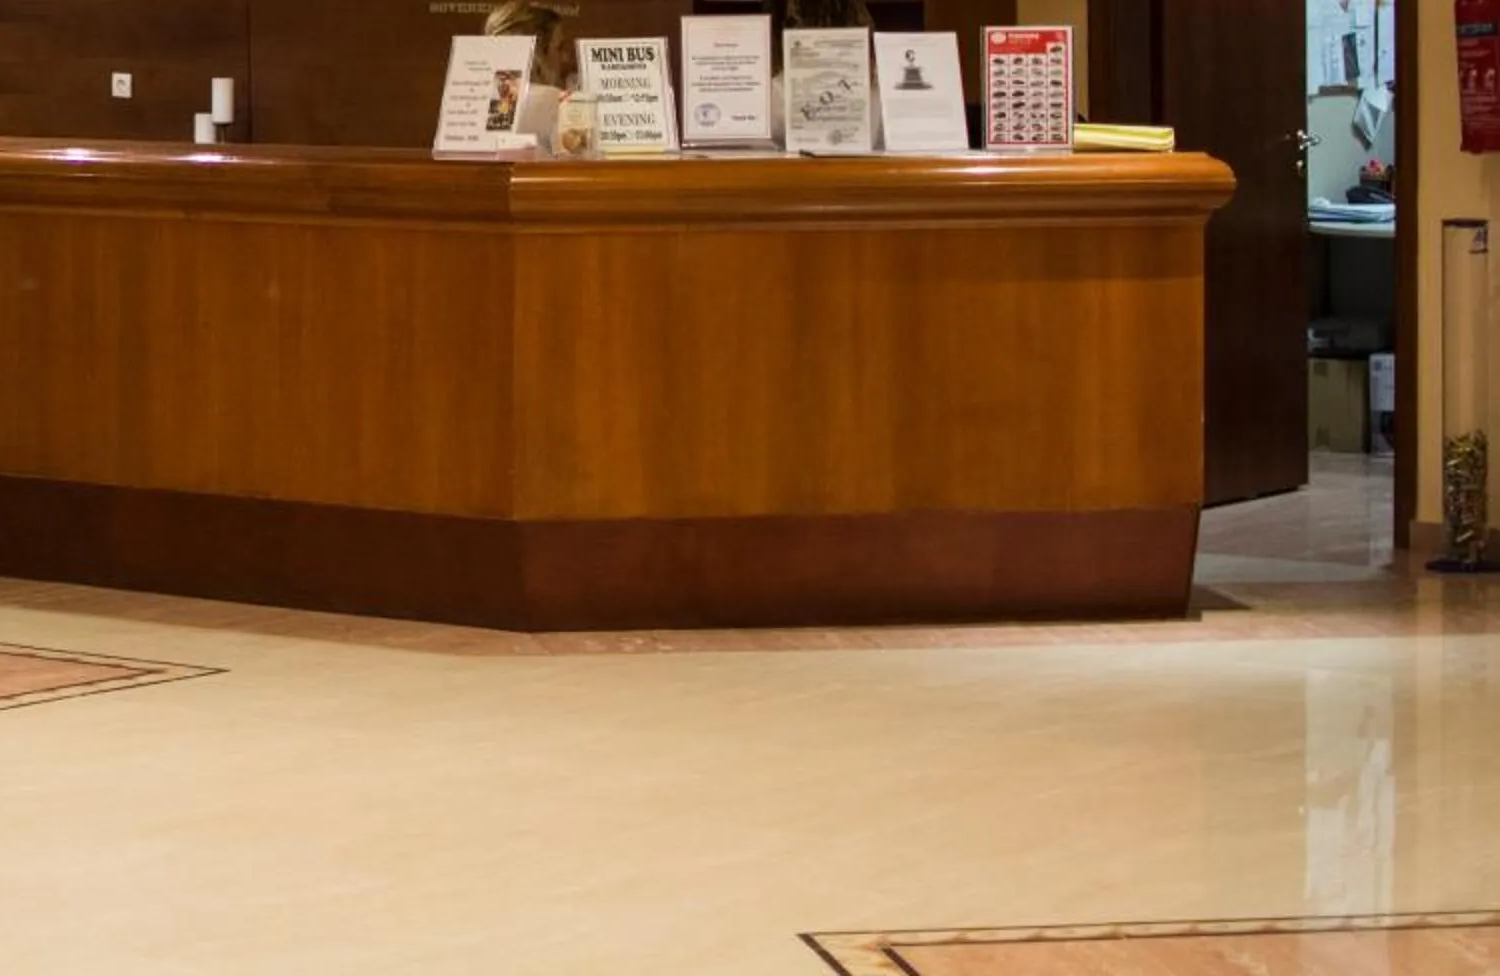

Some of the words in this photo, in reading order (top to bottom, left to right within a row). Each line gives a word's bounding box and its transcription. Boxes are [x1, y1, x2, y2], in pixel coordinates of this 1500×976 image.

[591, 47, 624, 62] MINI
[626, 46, 655, 62] BUS
[601, 77, 651, 89] MORNING
[603, 112, 655, 126] EVENING
